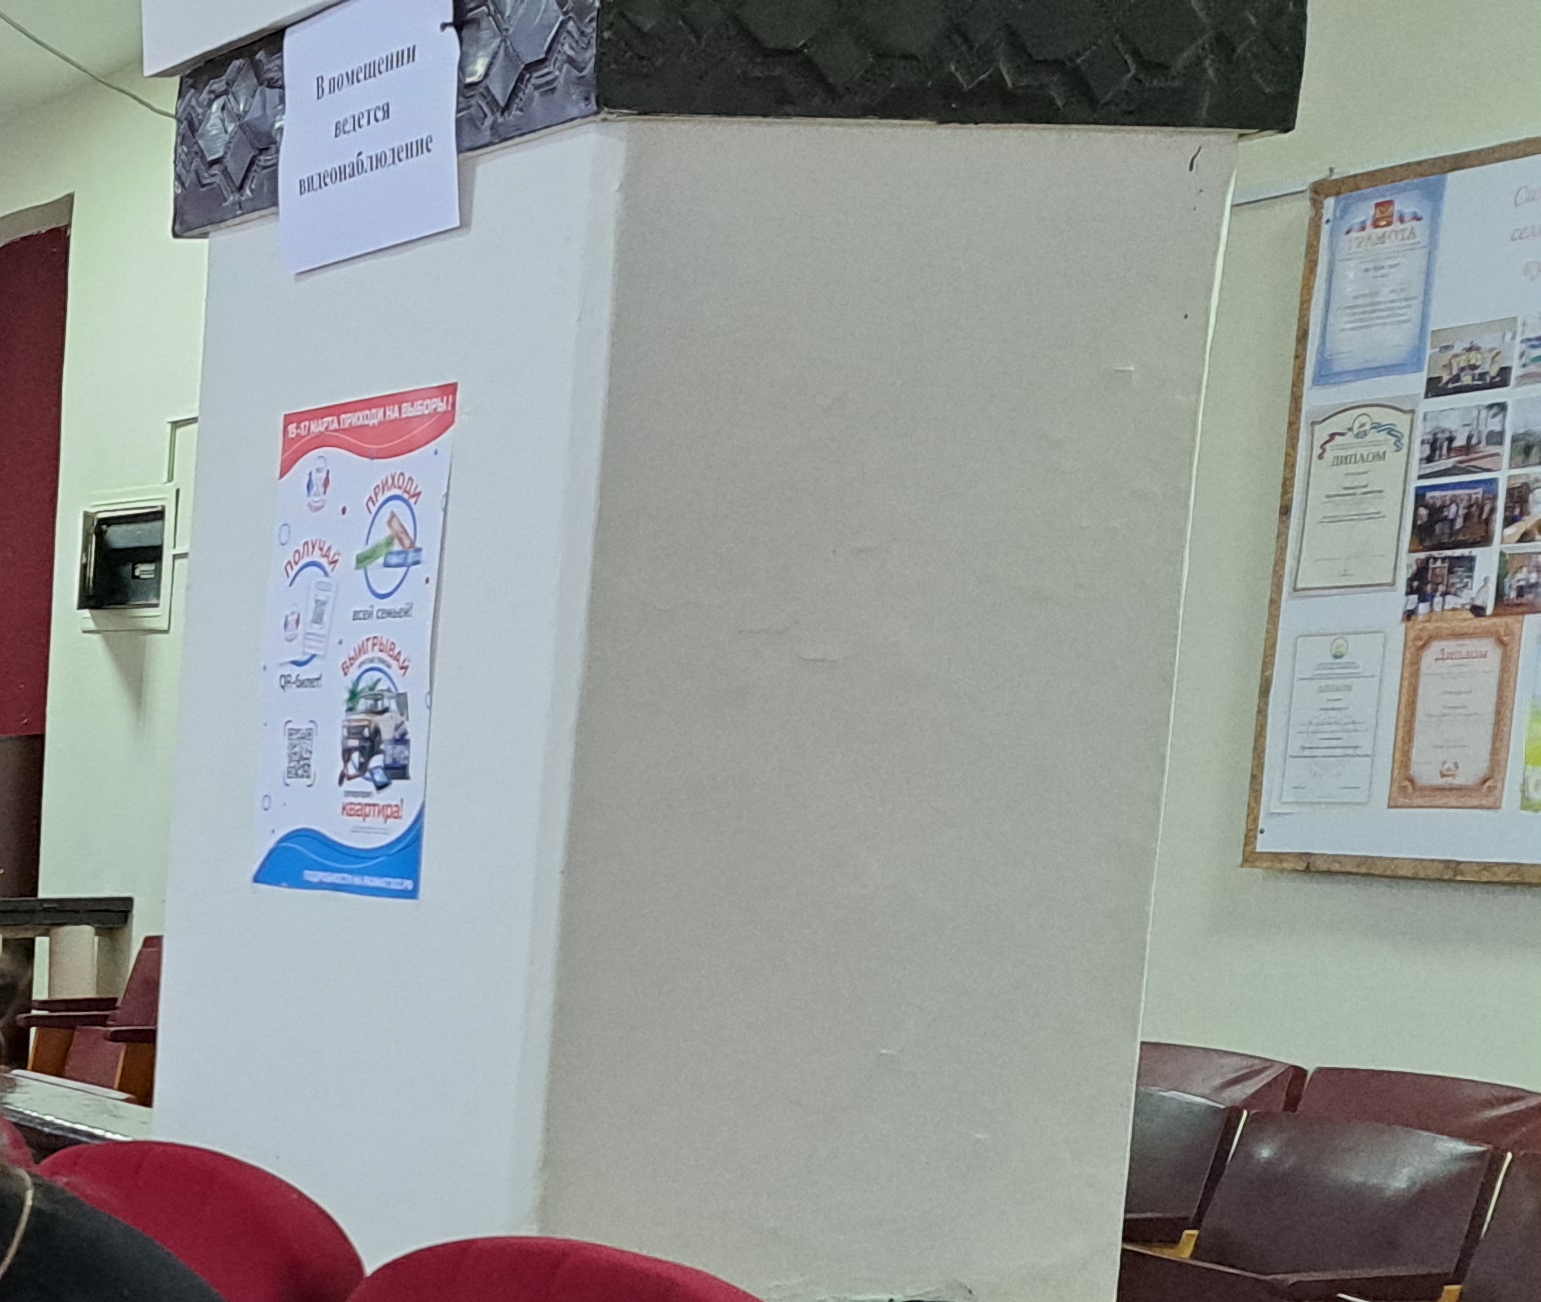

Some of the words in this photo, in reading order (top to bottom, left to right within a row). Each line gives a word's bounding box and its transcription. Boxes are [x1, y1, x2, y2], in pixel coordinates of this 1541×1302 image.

[315, 74, 325, 100] В
[328, 44, 417, 95] помещении
[333, 101, 391, 139] ведется
[297, 133, 434, 196] видеонаблюдение
